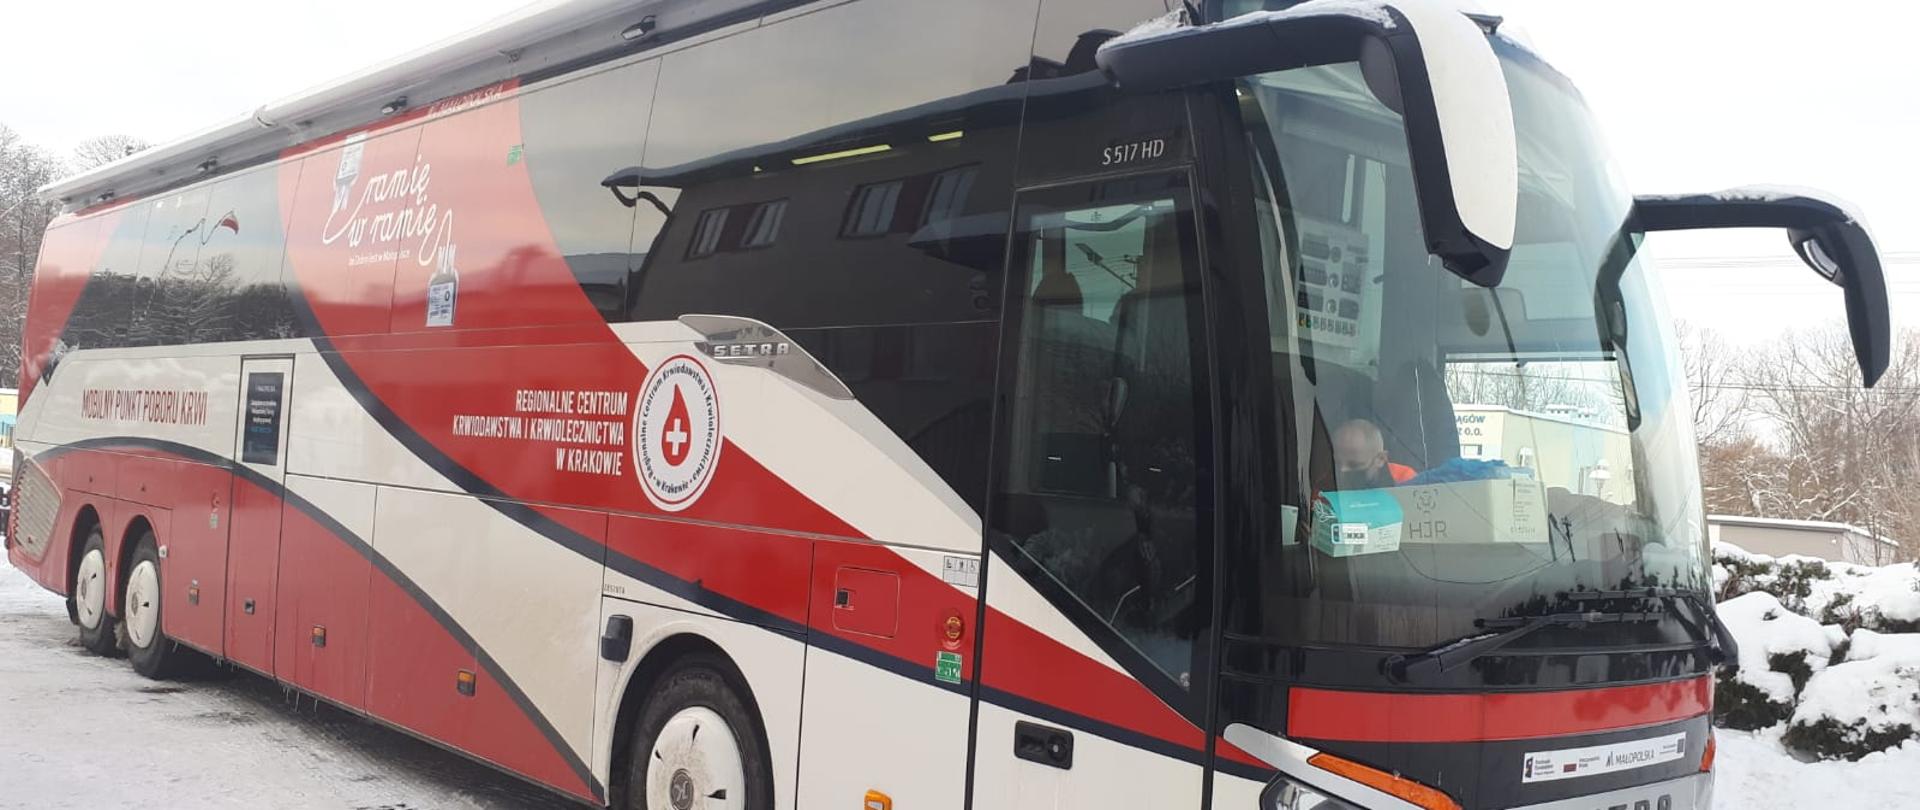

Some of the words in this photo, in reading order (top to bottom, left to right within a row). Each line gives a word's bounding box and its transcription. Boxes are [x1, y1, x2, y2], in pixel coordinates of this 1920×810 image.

[1102, 147, 1112, 165] S
[1113, 143, 1138, 164] 517
[1141, 139, 1164, 159] HD
[366, 153, 430, 205] ramię
[348, 216, 367, 247] w
[370, 203, 437, 244] ramię
[714, 342, 789, 356] SETRA
[81, 389, 115, 420] MOBILNY
[115, 389, 142, 421] PUNKT
[143, 390, 179, 424] POBORU
[180, 391, 208, 426] KRWI
[515, 389, 575, 414] REGIONALNE
[577, 391, 628, 416] CENTRUM
[643, 377, 664, 417] Centrum
[452, 414, 522, 440] KRWIODAWSTWA
[524, 418, 529, 440] I
[530, 418, 624, 446] KRWIOLECZNICTWA
[556, 447, 566, 471] W
[567, 448, 623, 477] KRAKOWIE
[1615, 749, 1655, 765] MAŁOPOLSKA
